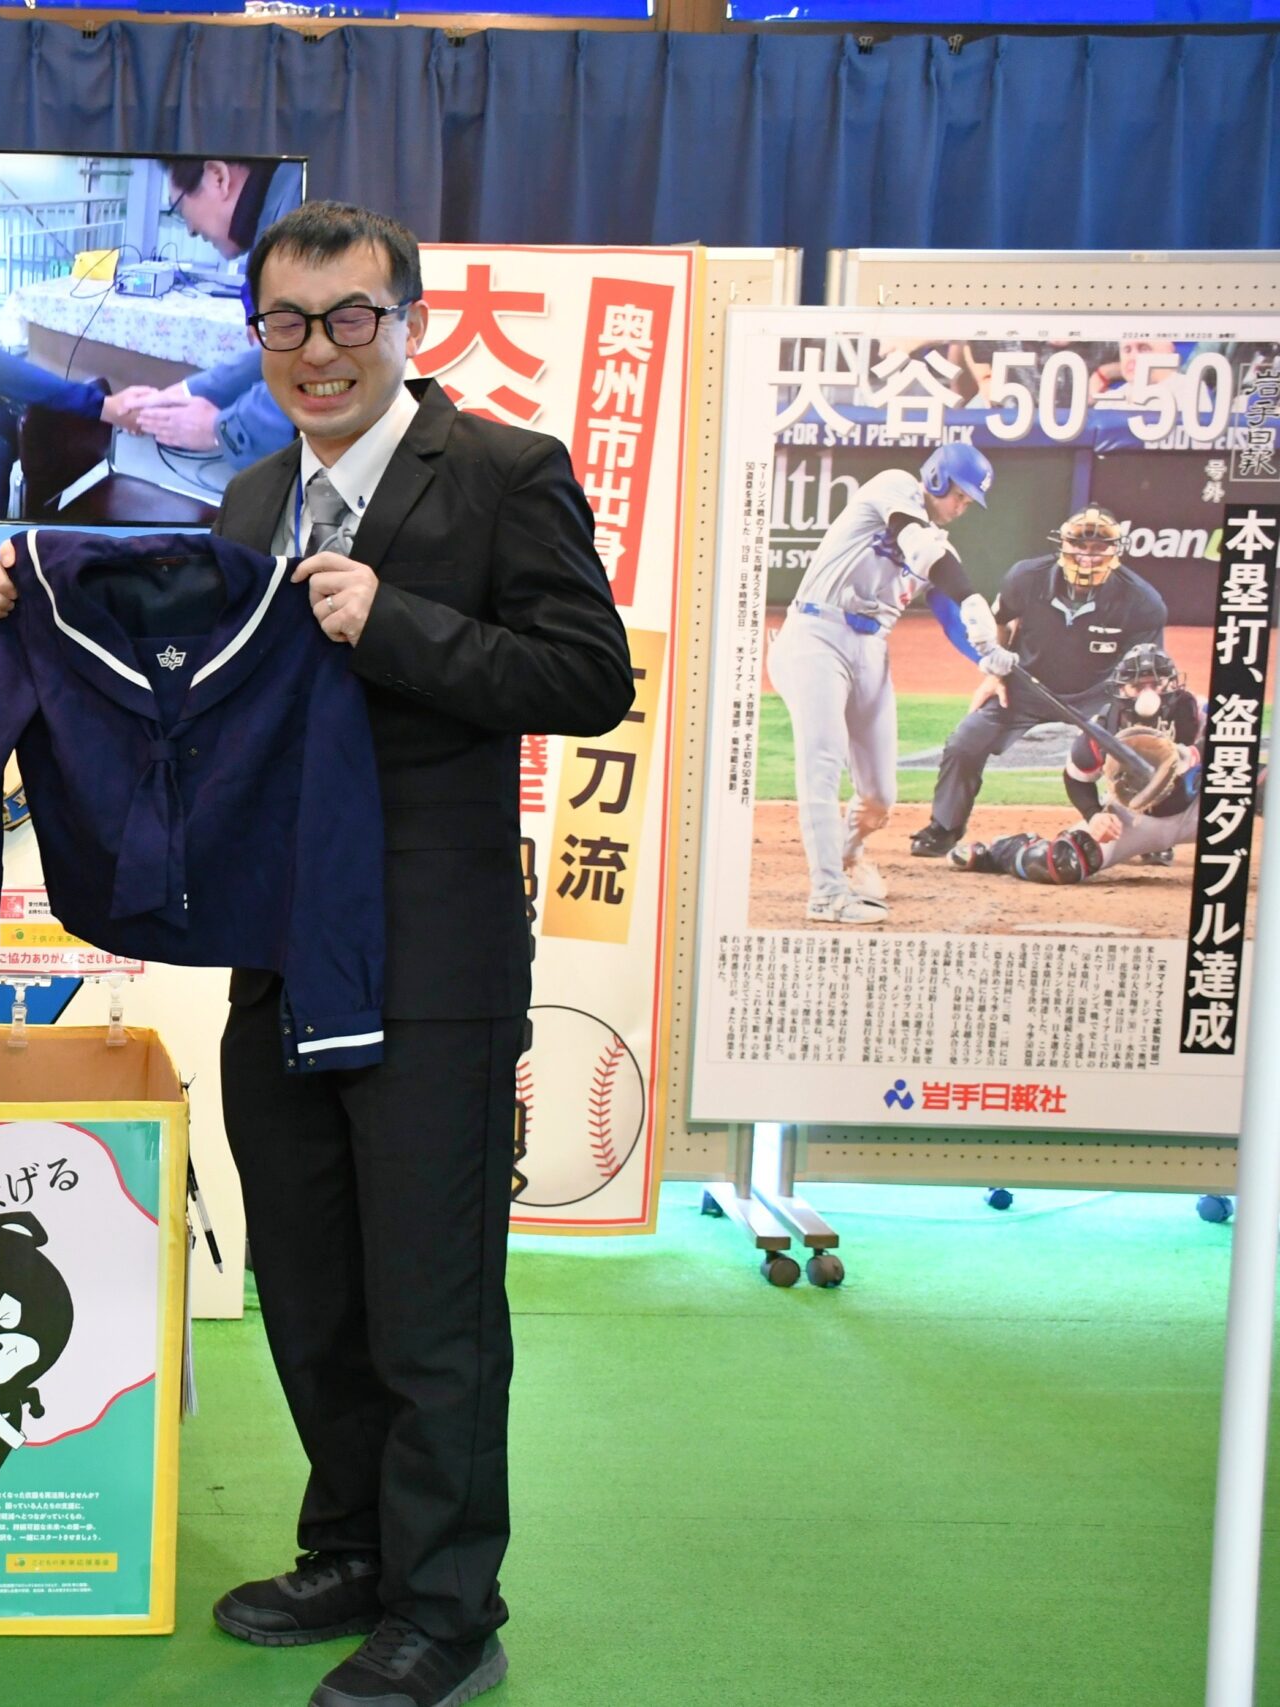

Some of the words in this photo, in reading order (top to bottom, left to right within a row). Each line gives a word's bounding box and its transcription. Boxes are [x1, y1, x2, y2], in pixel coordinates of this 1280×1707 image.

[583, 303, 654, 582] 奥州市出身
[1202, 459, 1227, 503] 号外
[1183, 508, 1277, 1051] 本塁打、盗塁ダブル達成
[921, 1080, 1068, 1113] 岩手日報社
